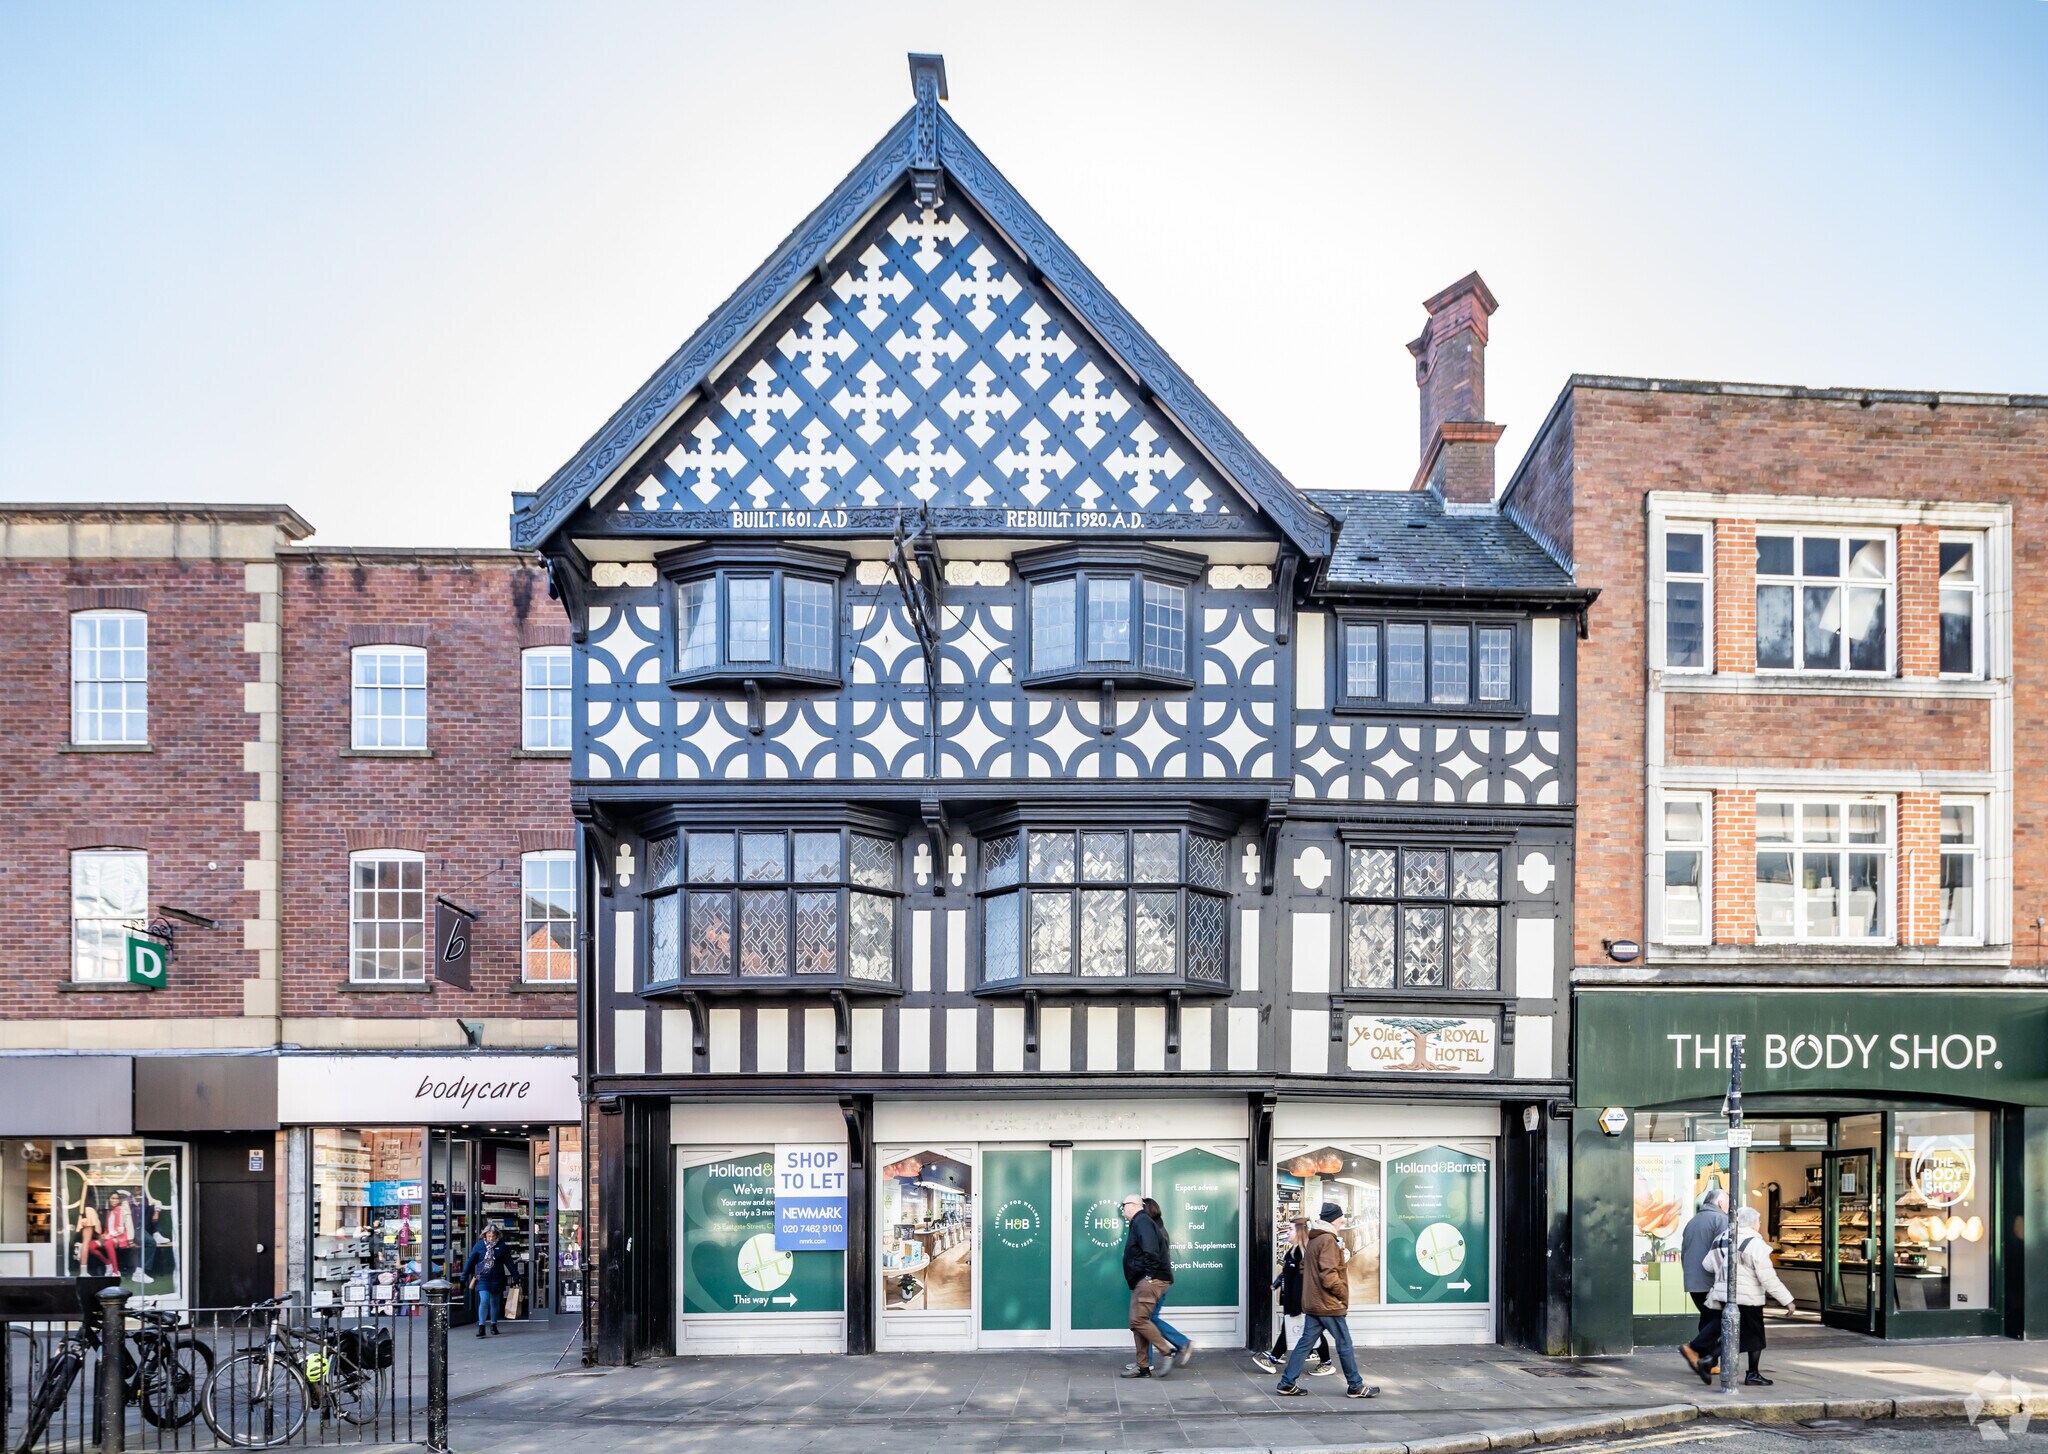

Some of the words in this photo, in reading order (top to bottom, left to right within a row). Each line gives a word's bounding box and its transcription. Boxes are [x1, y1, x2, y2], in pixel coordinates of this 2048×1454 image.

[442, 918, 466, 963] b
[135, 945, 162, 979] D
[1349, 1027, 1370, 1046] Ye
[1444, 1029, 1489, 1043] ROYAL
[1371, 1047, 1404, 1061] OAK
[1435, 1048, 1485, 1062] HOTEL
[1667, 1034, 1747, 1069] THE
[1765, 1034, 1879, 1070] BODY
[415, 1075, 531, 1109] bodycare
[787, 1152, 838, 1168] SHOP
[1932, 1157, 1954, 1168] THE
[781, 1173, 804, 1189] TO
[810, 1172, 845, 1189] LET
[1924, 1168, 1963, 1181] BODY
[733, 1184, 763, 1195] We've
[1175, 1184, 1197, 1193] Expert
[1926, 1181, 1961, 1193] SHOP
[721, 1198, 737, 1207] Your
[753, 1198, 765, 1206] and
[1185, 1203, 1208, 1212] Beauty
[735, 1209, 749, 1219] only
[782, 1207, 842, 1220] NEWMARK
[782, 1224, 798, 1234] 020
[800, 1224, 820, 1234] 7462
[822, 1224, 843, 1233] 9100
[1005, 1218, 1030, 1230] H&B
[1095, 1218, 1119, 1229] H&B
[1188, 1222, 1205, 1230] Food
[1194, 1241, 1236, 1251] Supplements
[1170, 1261, 1191, 1271] Sports
[1192, 1261, 1223, 1269] Nutrition
[734, 1295, 752, 1304] This
[753, 1297, 769, 1307] way
